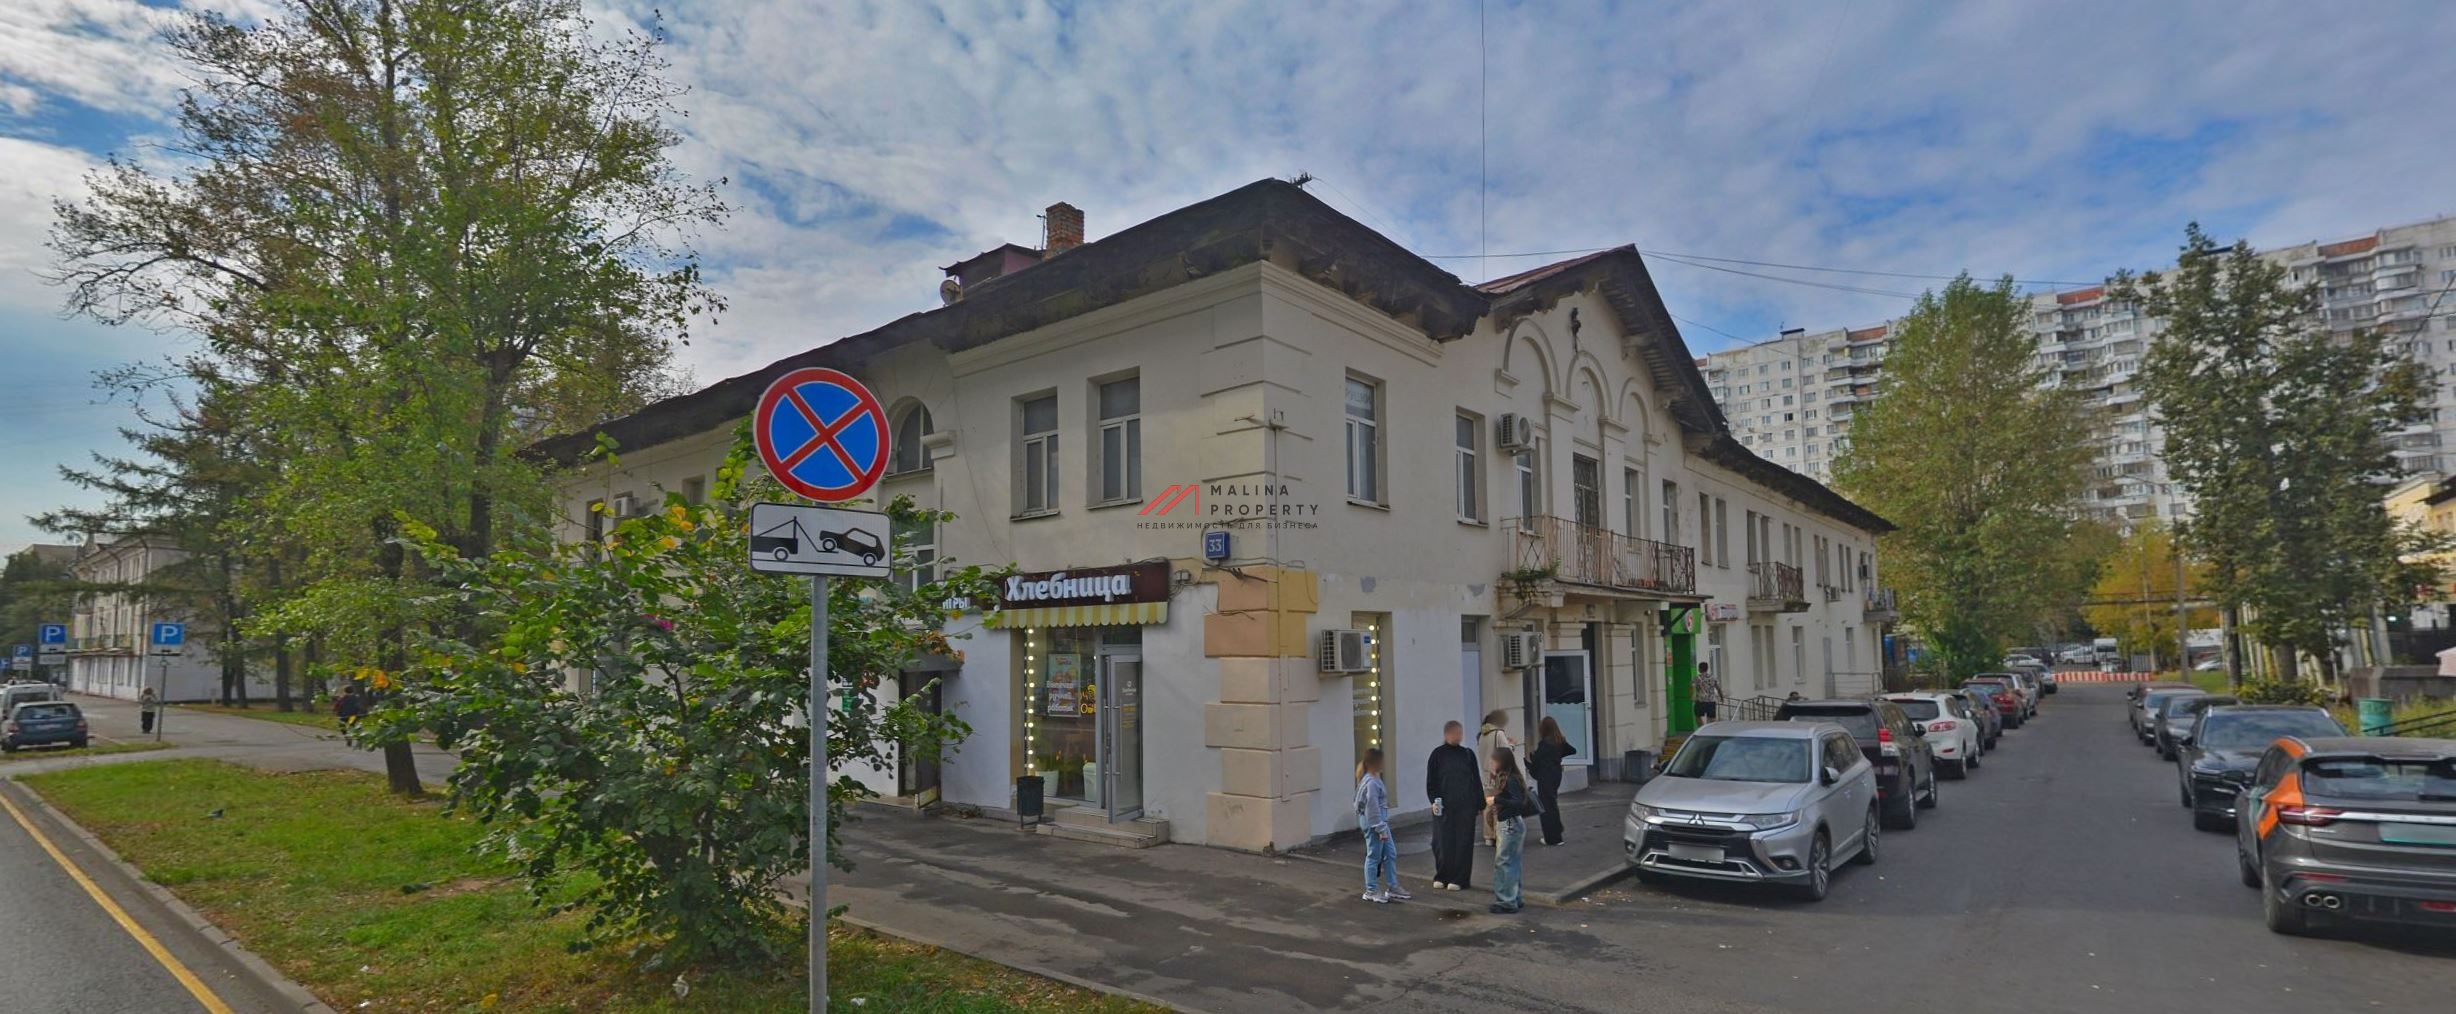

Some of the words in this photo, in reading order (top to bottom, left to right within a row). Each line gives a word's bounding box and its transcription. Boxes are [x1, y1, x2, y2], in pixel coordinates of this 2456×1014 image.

[1208, 538, 1222, 552] 33
[1004, 572, 1131, 602] Хлебница
[160, 625, 178, 643] P
